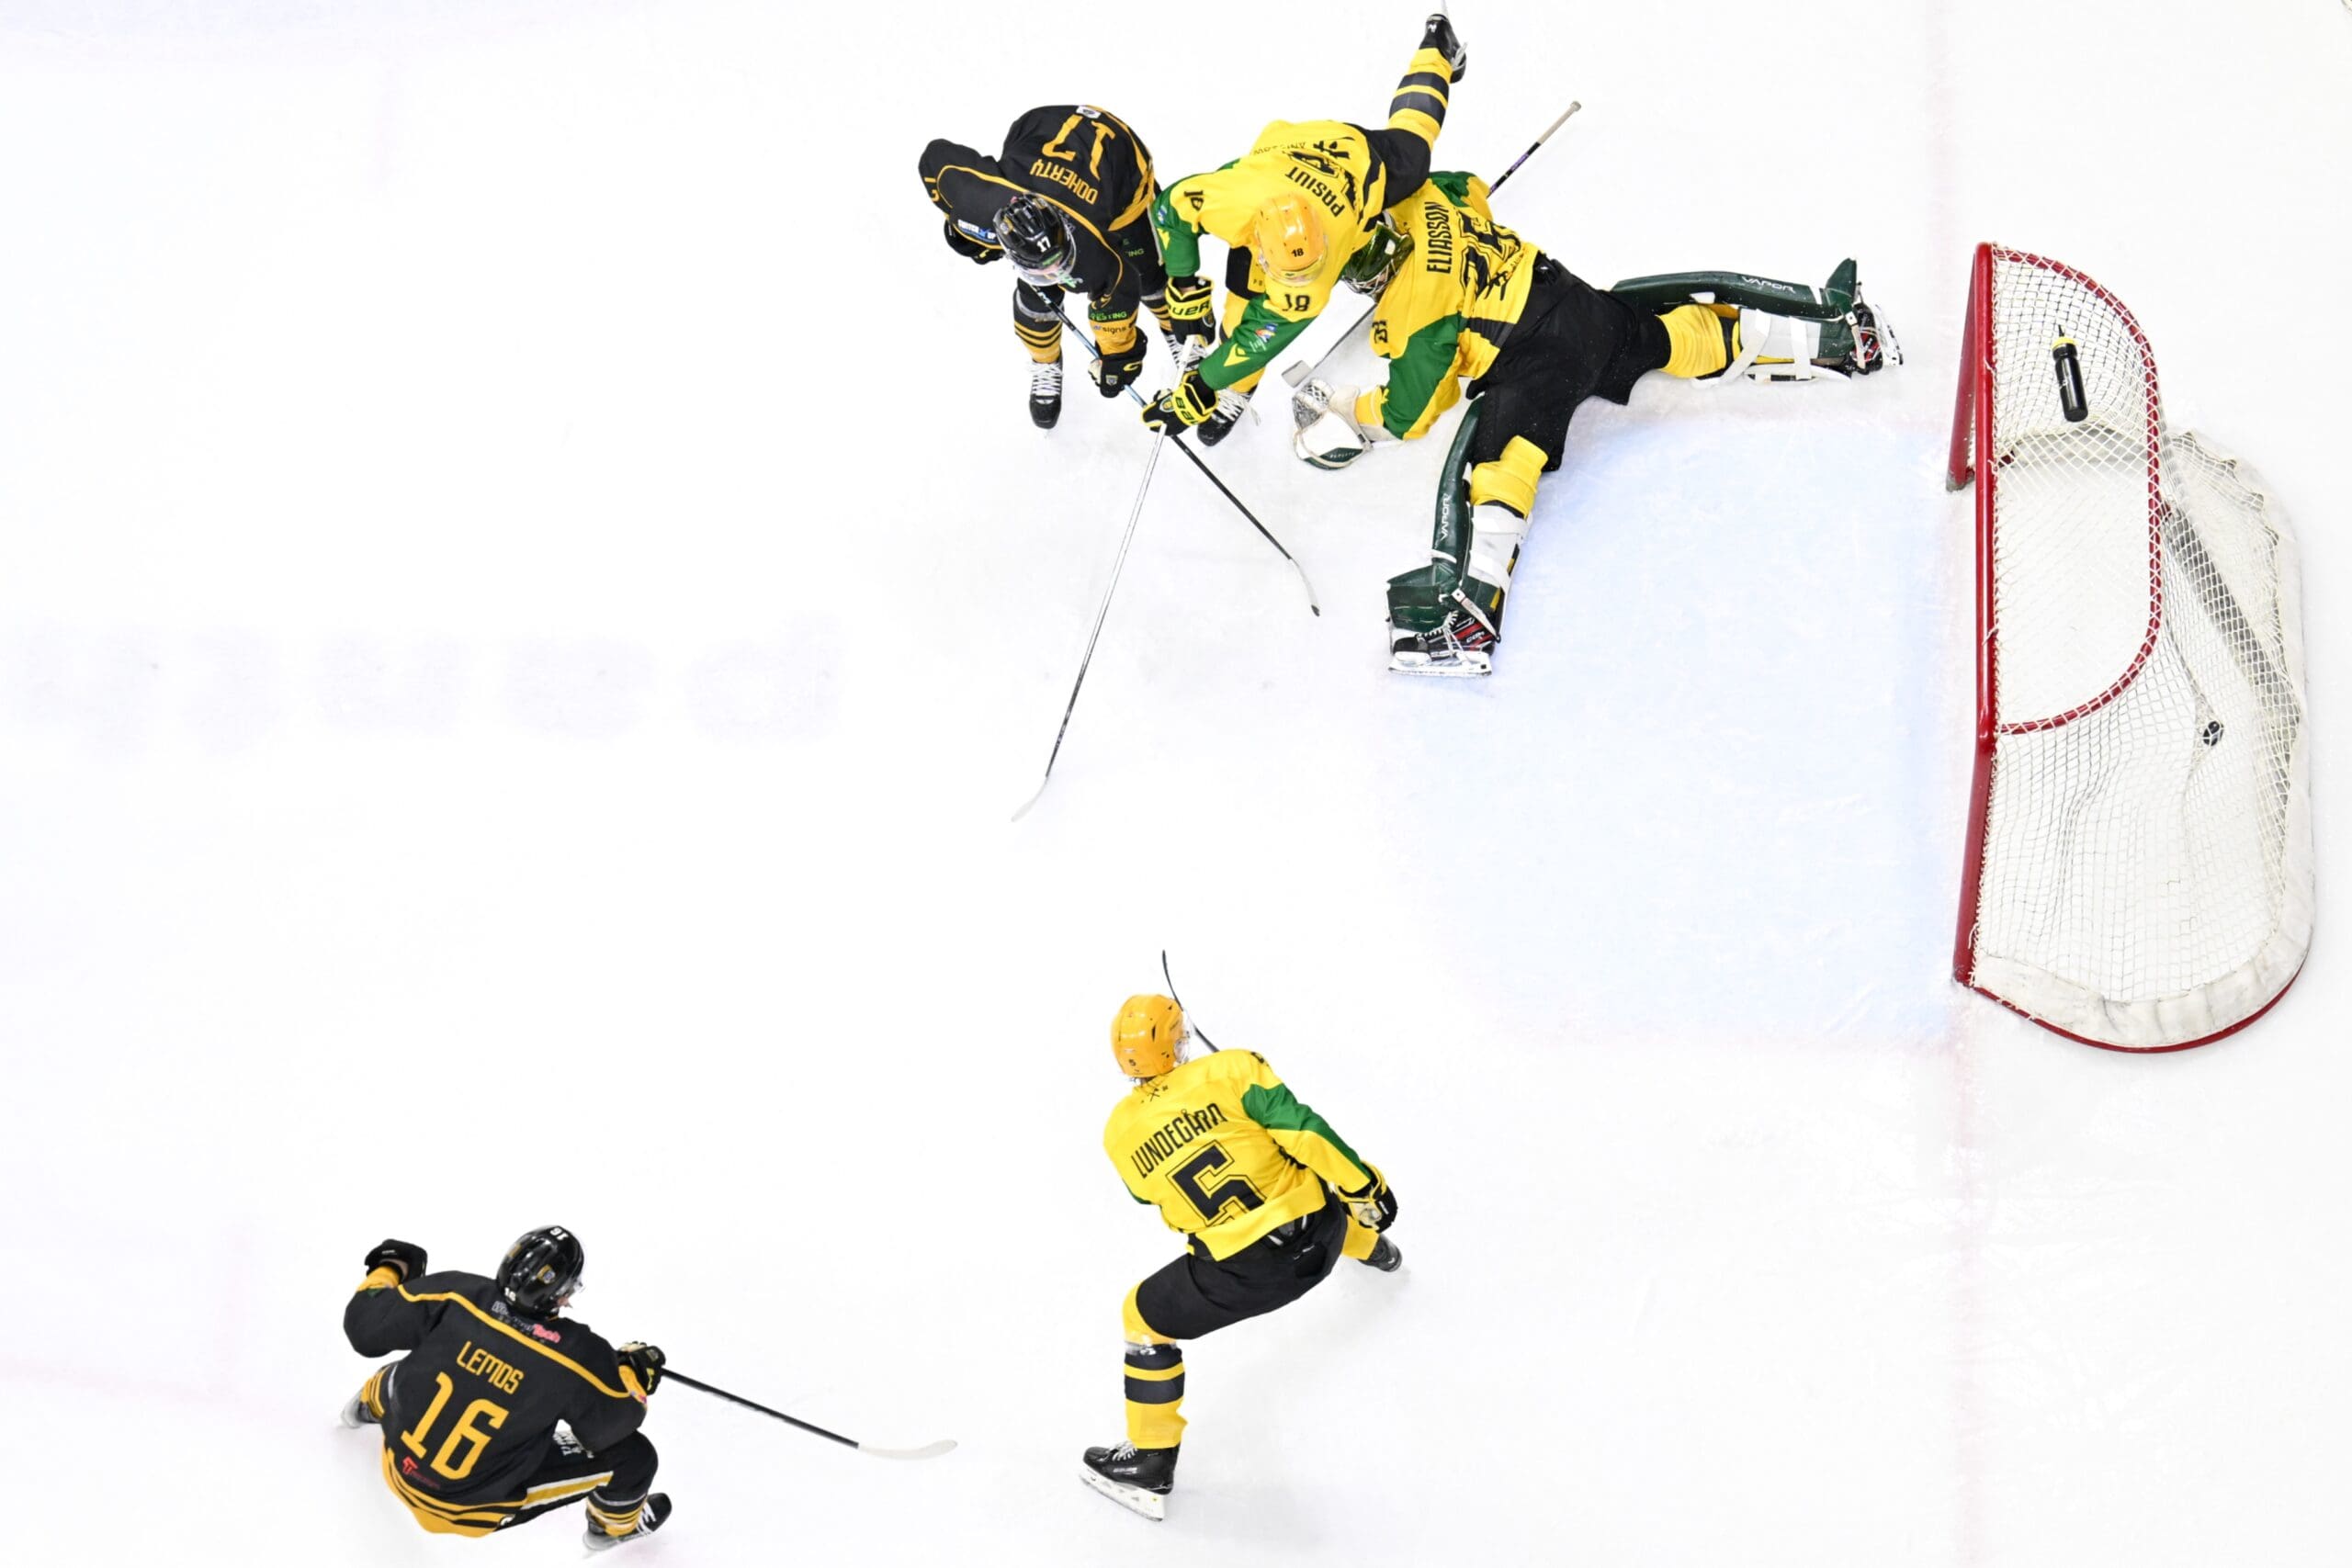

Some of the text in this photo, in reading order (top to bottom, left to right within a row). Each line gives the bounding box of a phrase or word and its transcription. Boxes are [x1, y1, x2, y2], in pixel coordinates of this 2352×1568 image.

[1042, 114, 1115, 182] 17
[1029, 159, 1098, 205] DOHERTY
[1285, 166, 1346, 217] PASIUT
[1036, 236, 1051, 253] 17
[1291, 248, 1305, 257] 18
[1425, 201, 1453, 274] ELIASSON
[1741, 276, 1796, 294] VAPOR
[1441, 492, 1452, 541] VAPOR
[1130, 1102, 1228, 1179] LUNDEGÅRD
[1164, 1139, 1266, 1227] 5
[456, 1340, 525, 1395] LEMOS
[400, 1371, 510, 1480] 16
